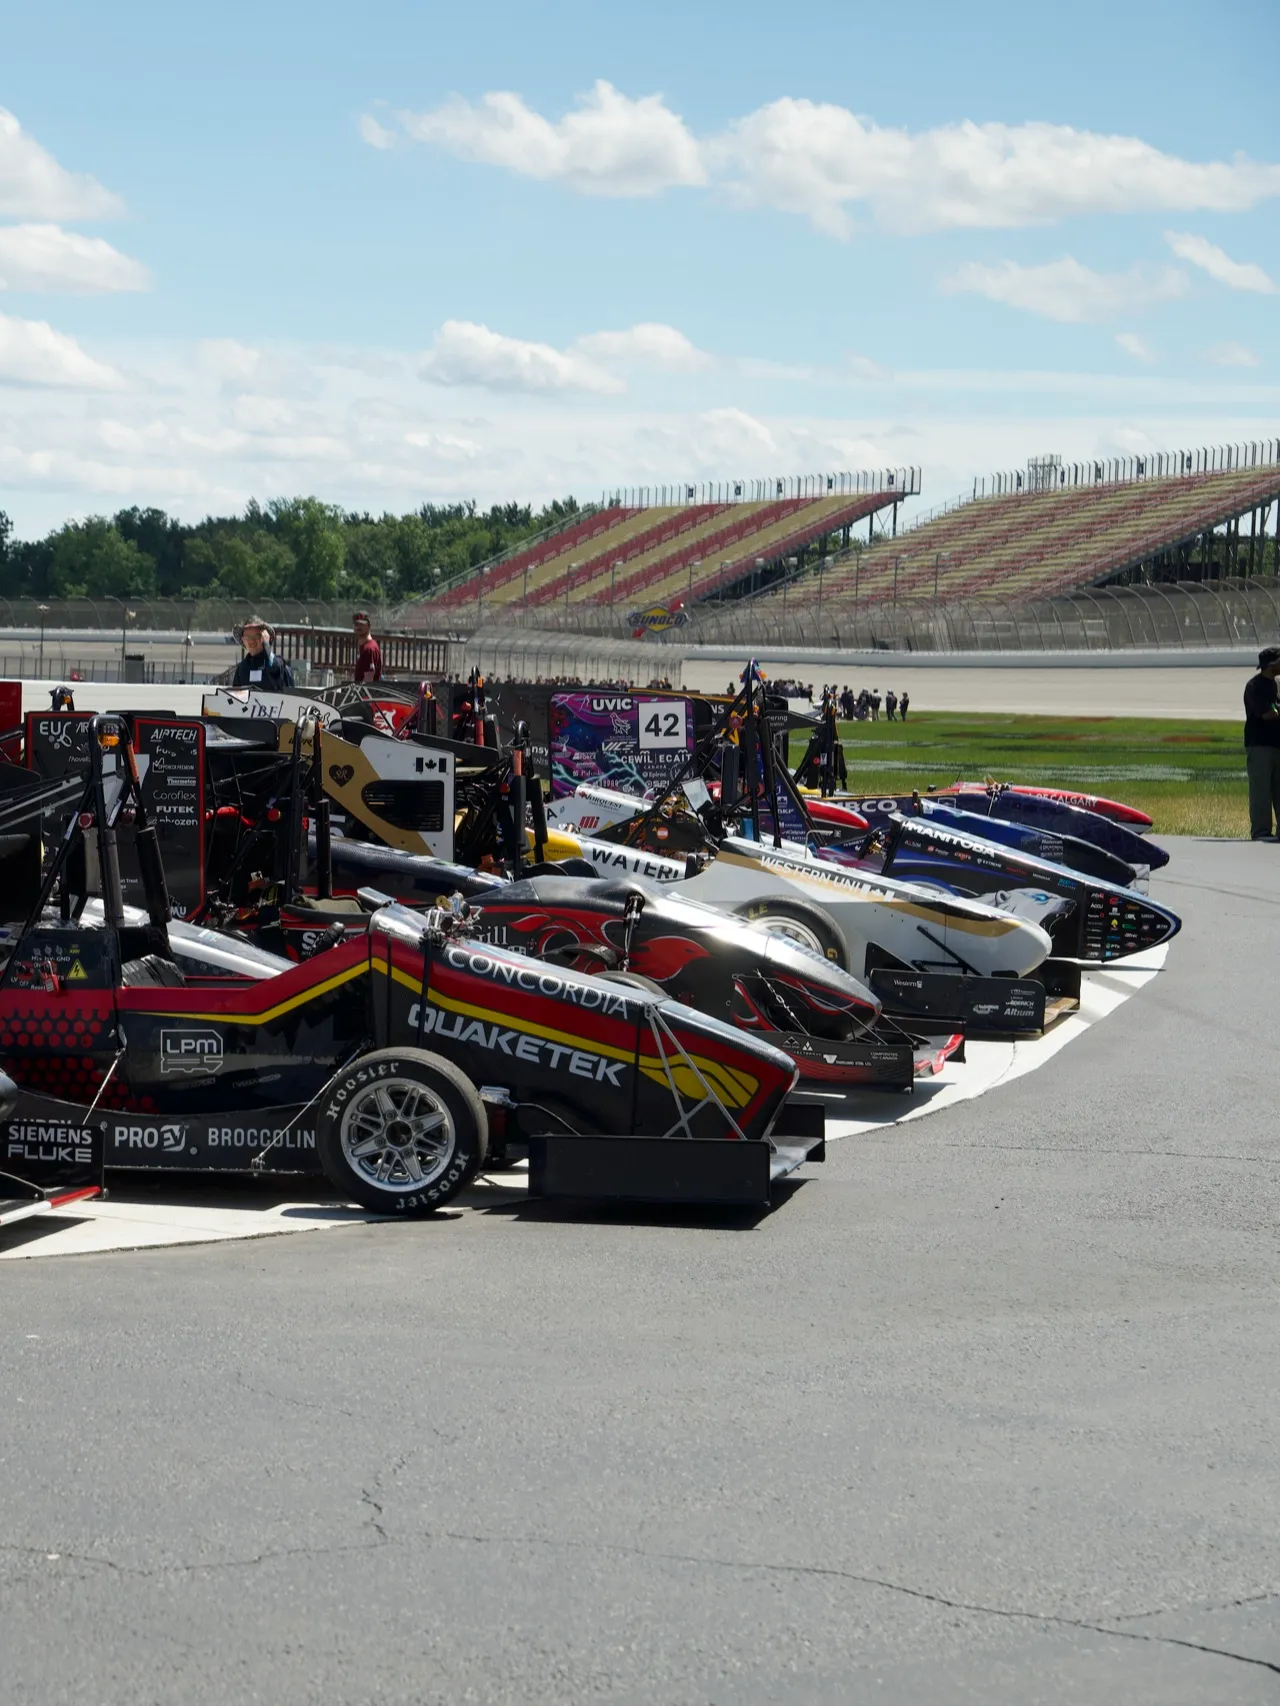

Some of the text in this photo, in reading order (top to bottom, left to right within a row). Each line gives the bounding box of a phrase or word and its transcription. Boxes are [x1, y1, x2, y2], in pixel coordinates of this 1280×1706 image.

[632, 615, 686, 626] SUNOCO
[592, 698, 632, 711] UVIC
[644, 713, 680, 737] 42
[152, 790, 197, 801] Coroflex
[1050, 794, 1098, 807] CALGARY
[156, 805, 195, 814] FUTEK
[761, 855, 830, 882] WESTERN
[474, 925, 508, 945] Gill
[448, 946, 629, 1020] CONCORDIA
[407, 1003, 628, 1087] QUAKETEK
[8, 1125, 93, 1145] SIEMENS
[114, 1126, 159, 1148] PRO
[208, 1128, 317, 1149] BROCCOLIN
[7, 1144, 93, 1163] FLUKE
